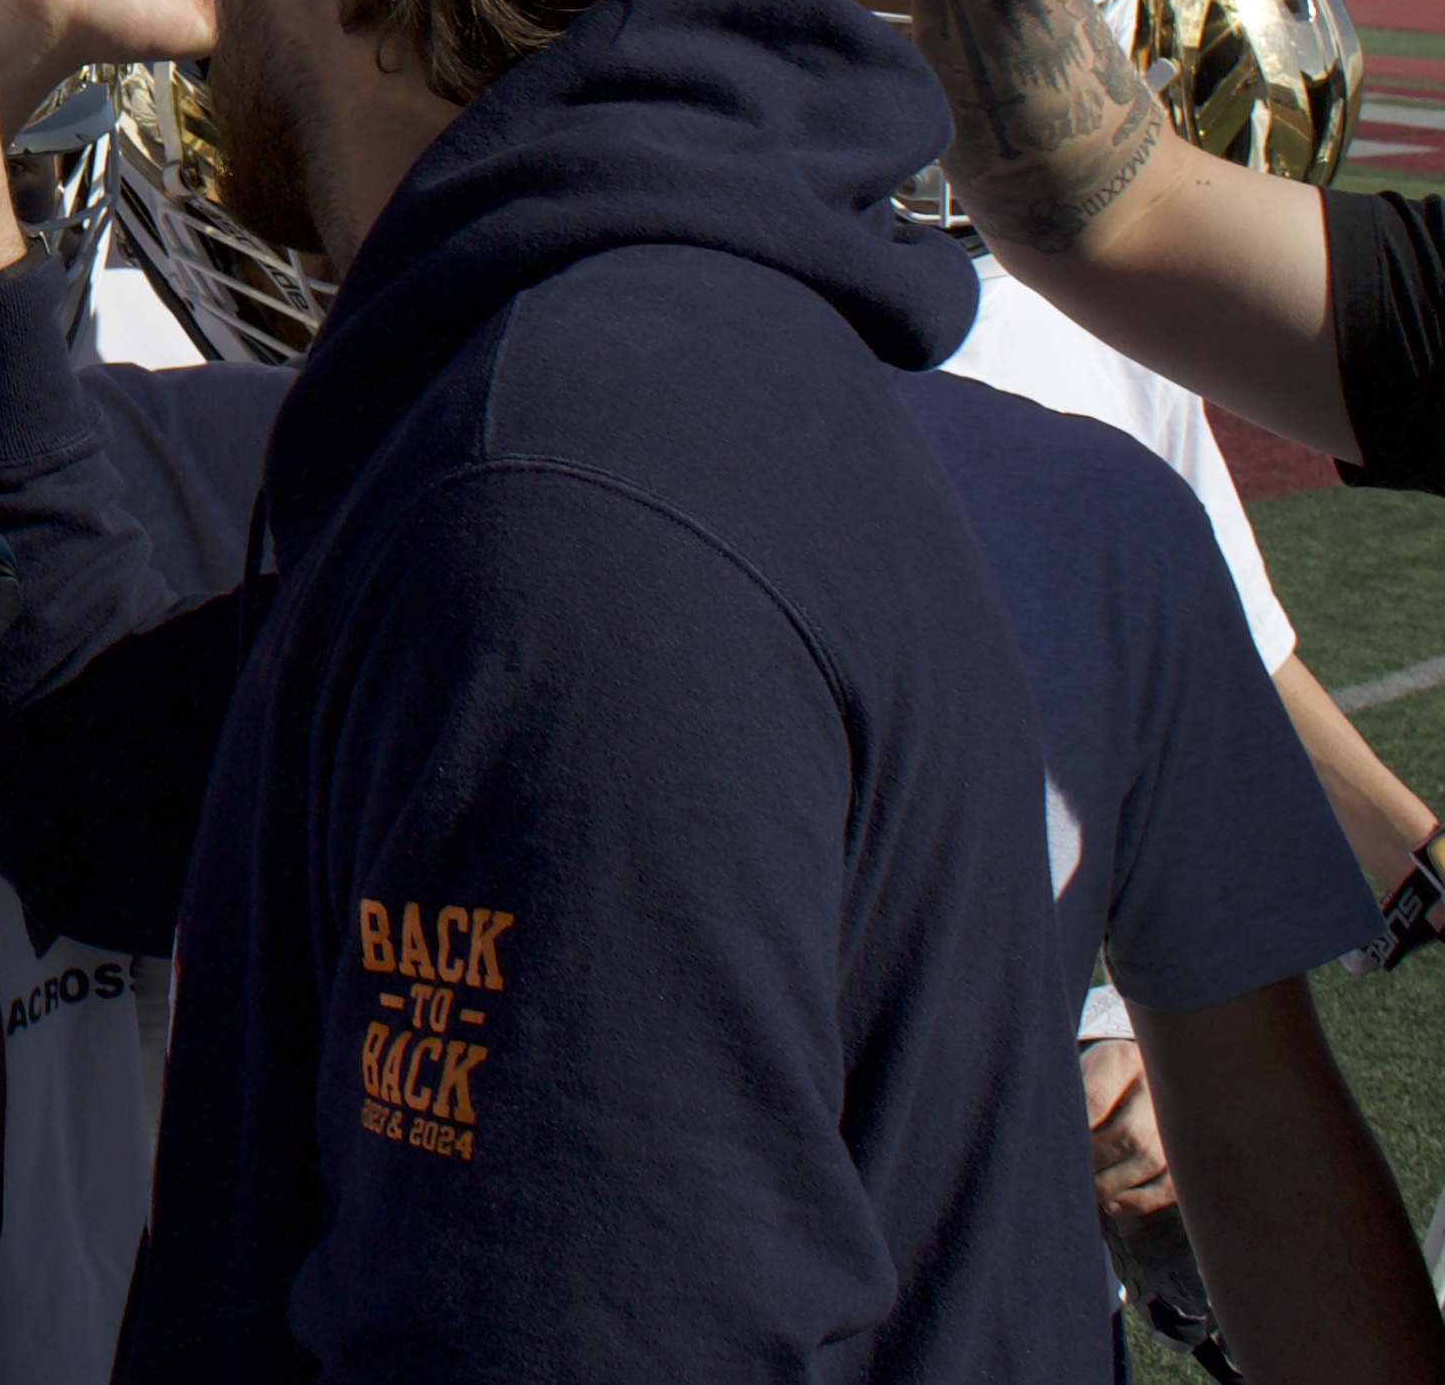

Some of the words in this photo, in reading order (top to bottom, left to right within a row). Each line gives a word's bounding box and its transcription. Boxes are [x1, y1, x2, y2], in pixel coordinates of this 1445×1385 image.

[359, 898, 515, 991] BACK
[361, 1020, 489, 1125] BACK
[408, 1117, 475, 1161] 2024
